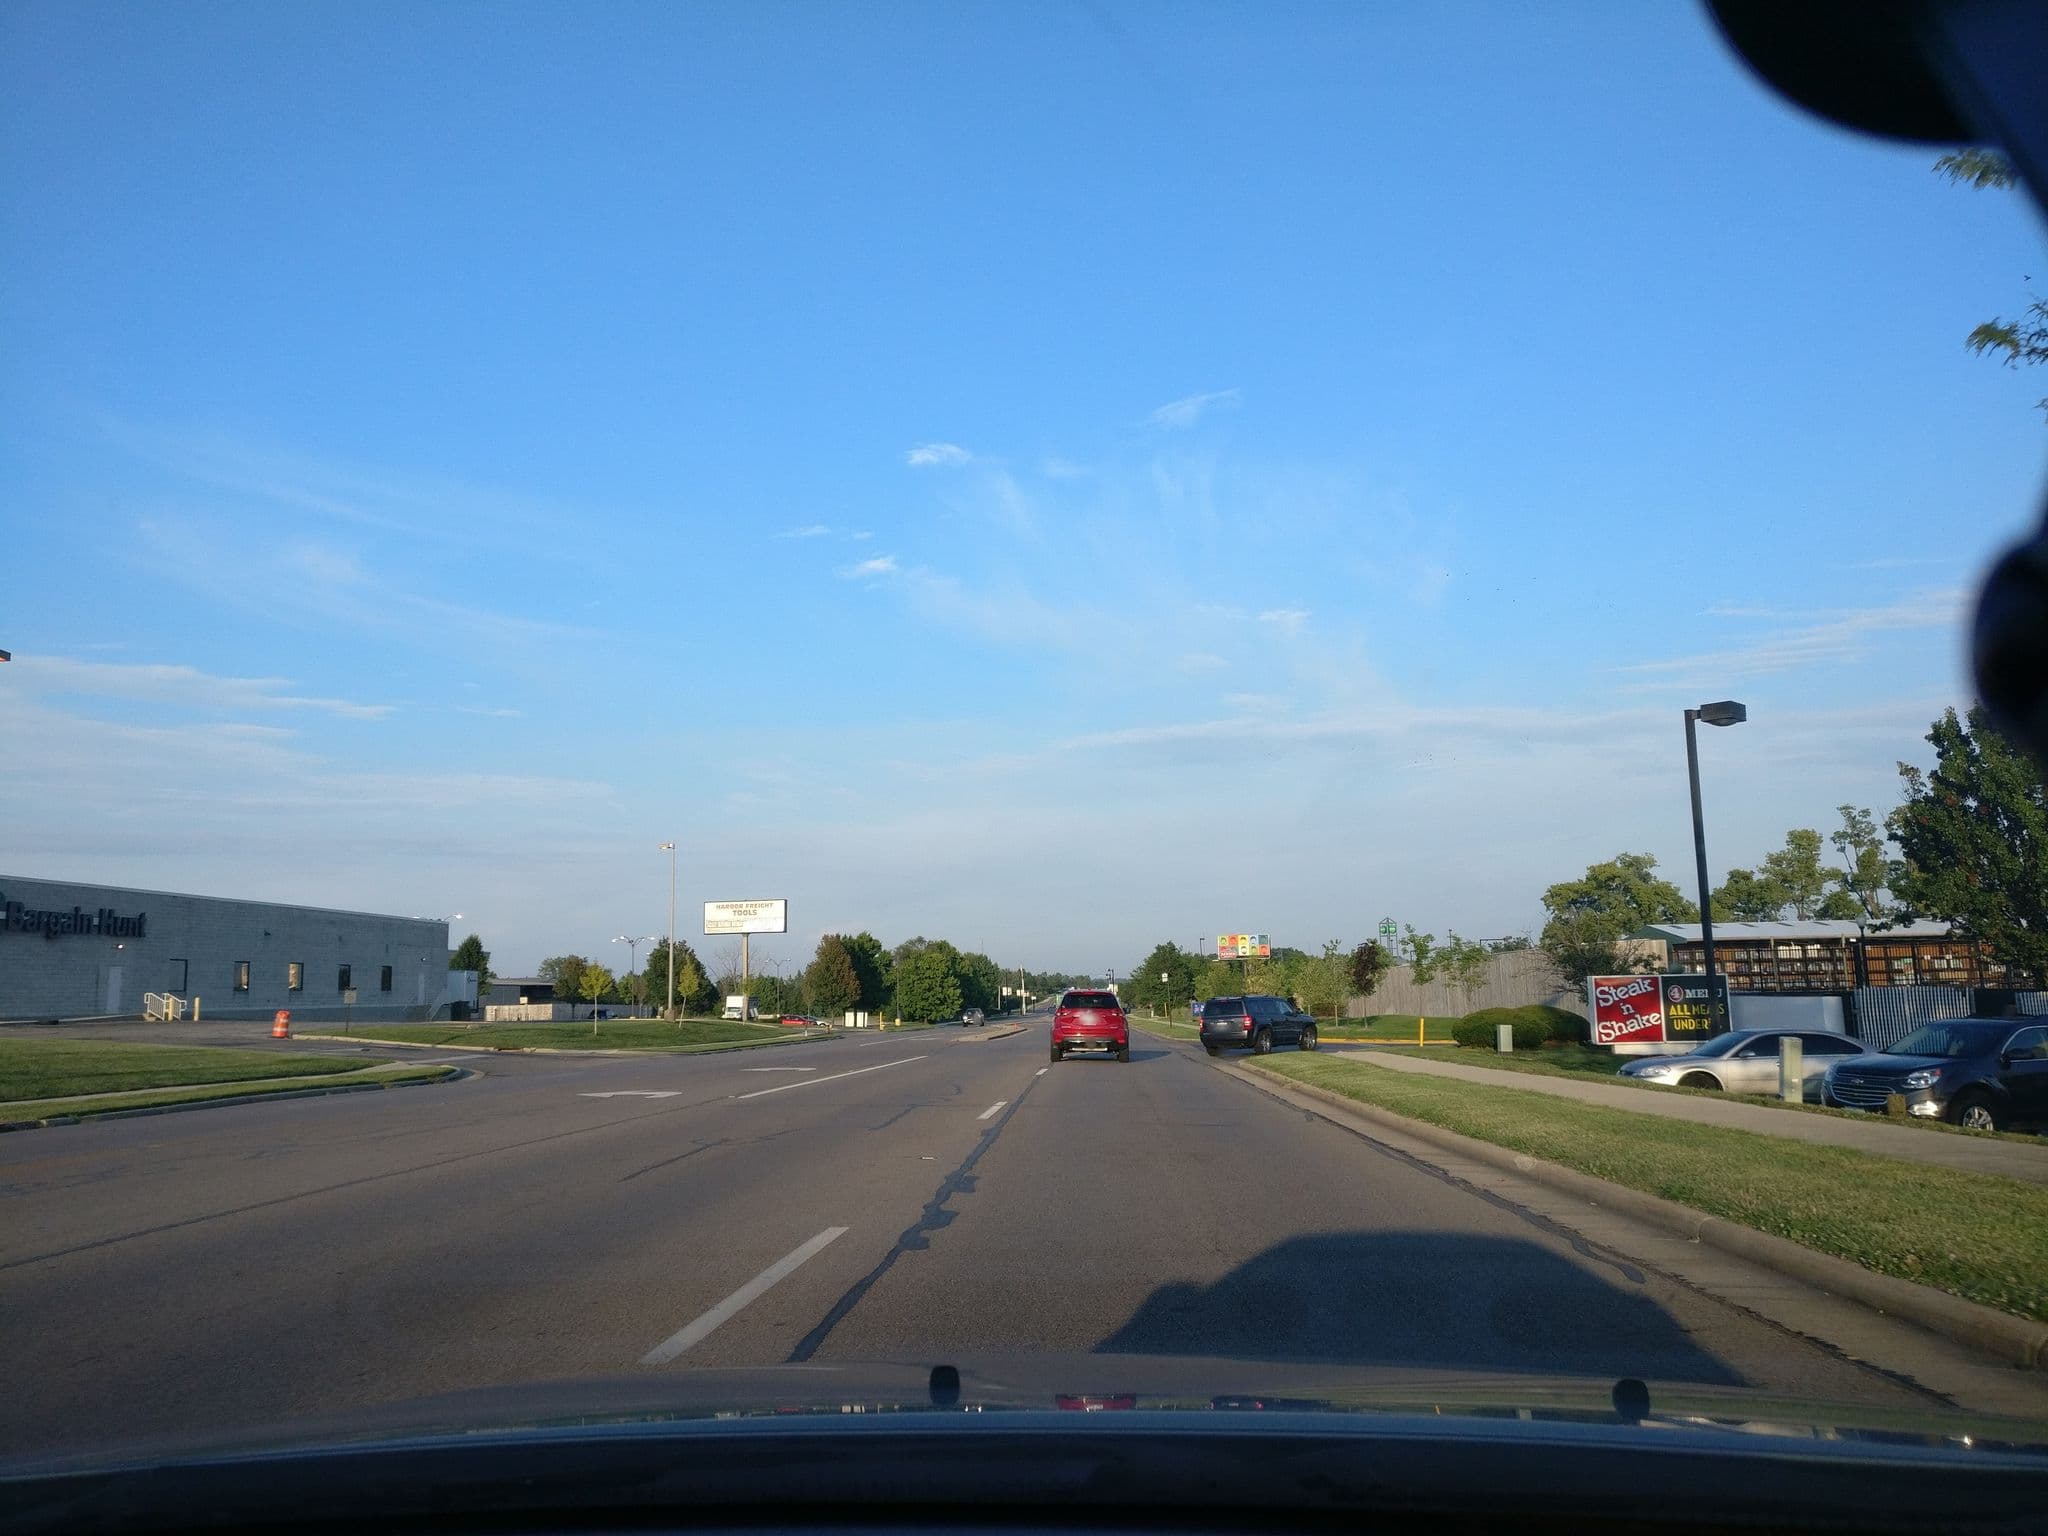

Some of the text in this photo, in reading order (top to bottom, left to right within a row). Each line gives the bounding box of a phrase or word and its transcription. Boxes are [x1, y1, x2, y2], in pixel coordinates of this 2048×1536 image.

[6, 901, 146, 938] Bargain Hunt
[1596, 978, 1655, 1007] Steak
[1669, 1004, 1691, 1015] ALL
[1598, 1012, 1662, 1042] Shake
[1674, 1018, 1708, 1031] UNDER
